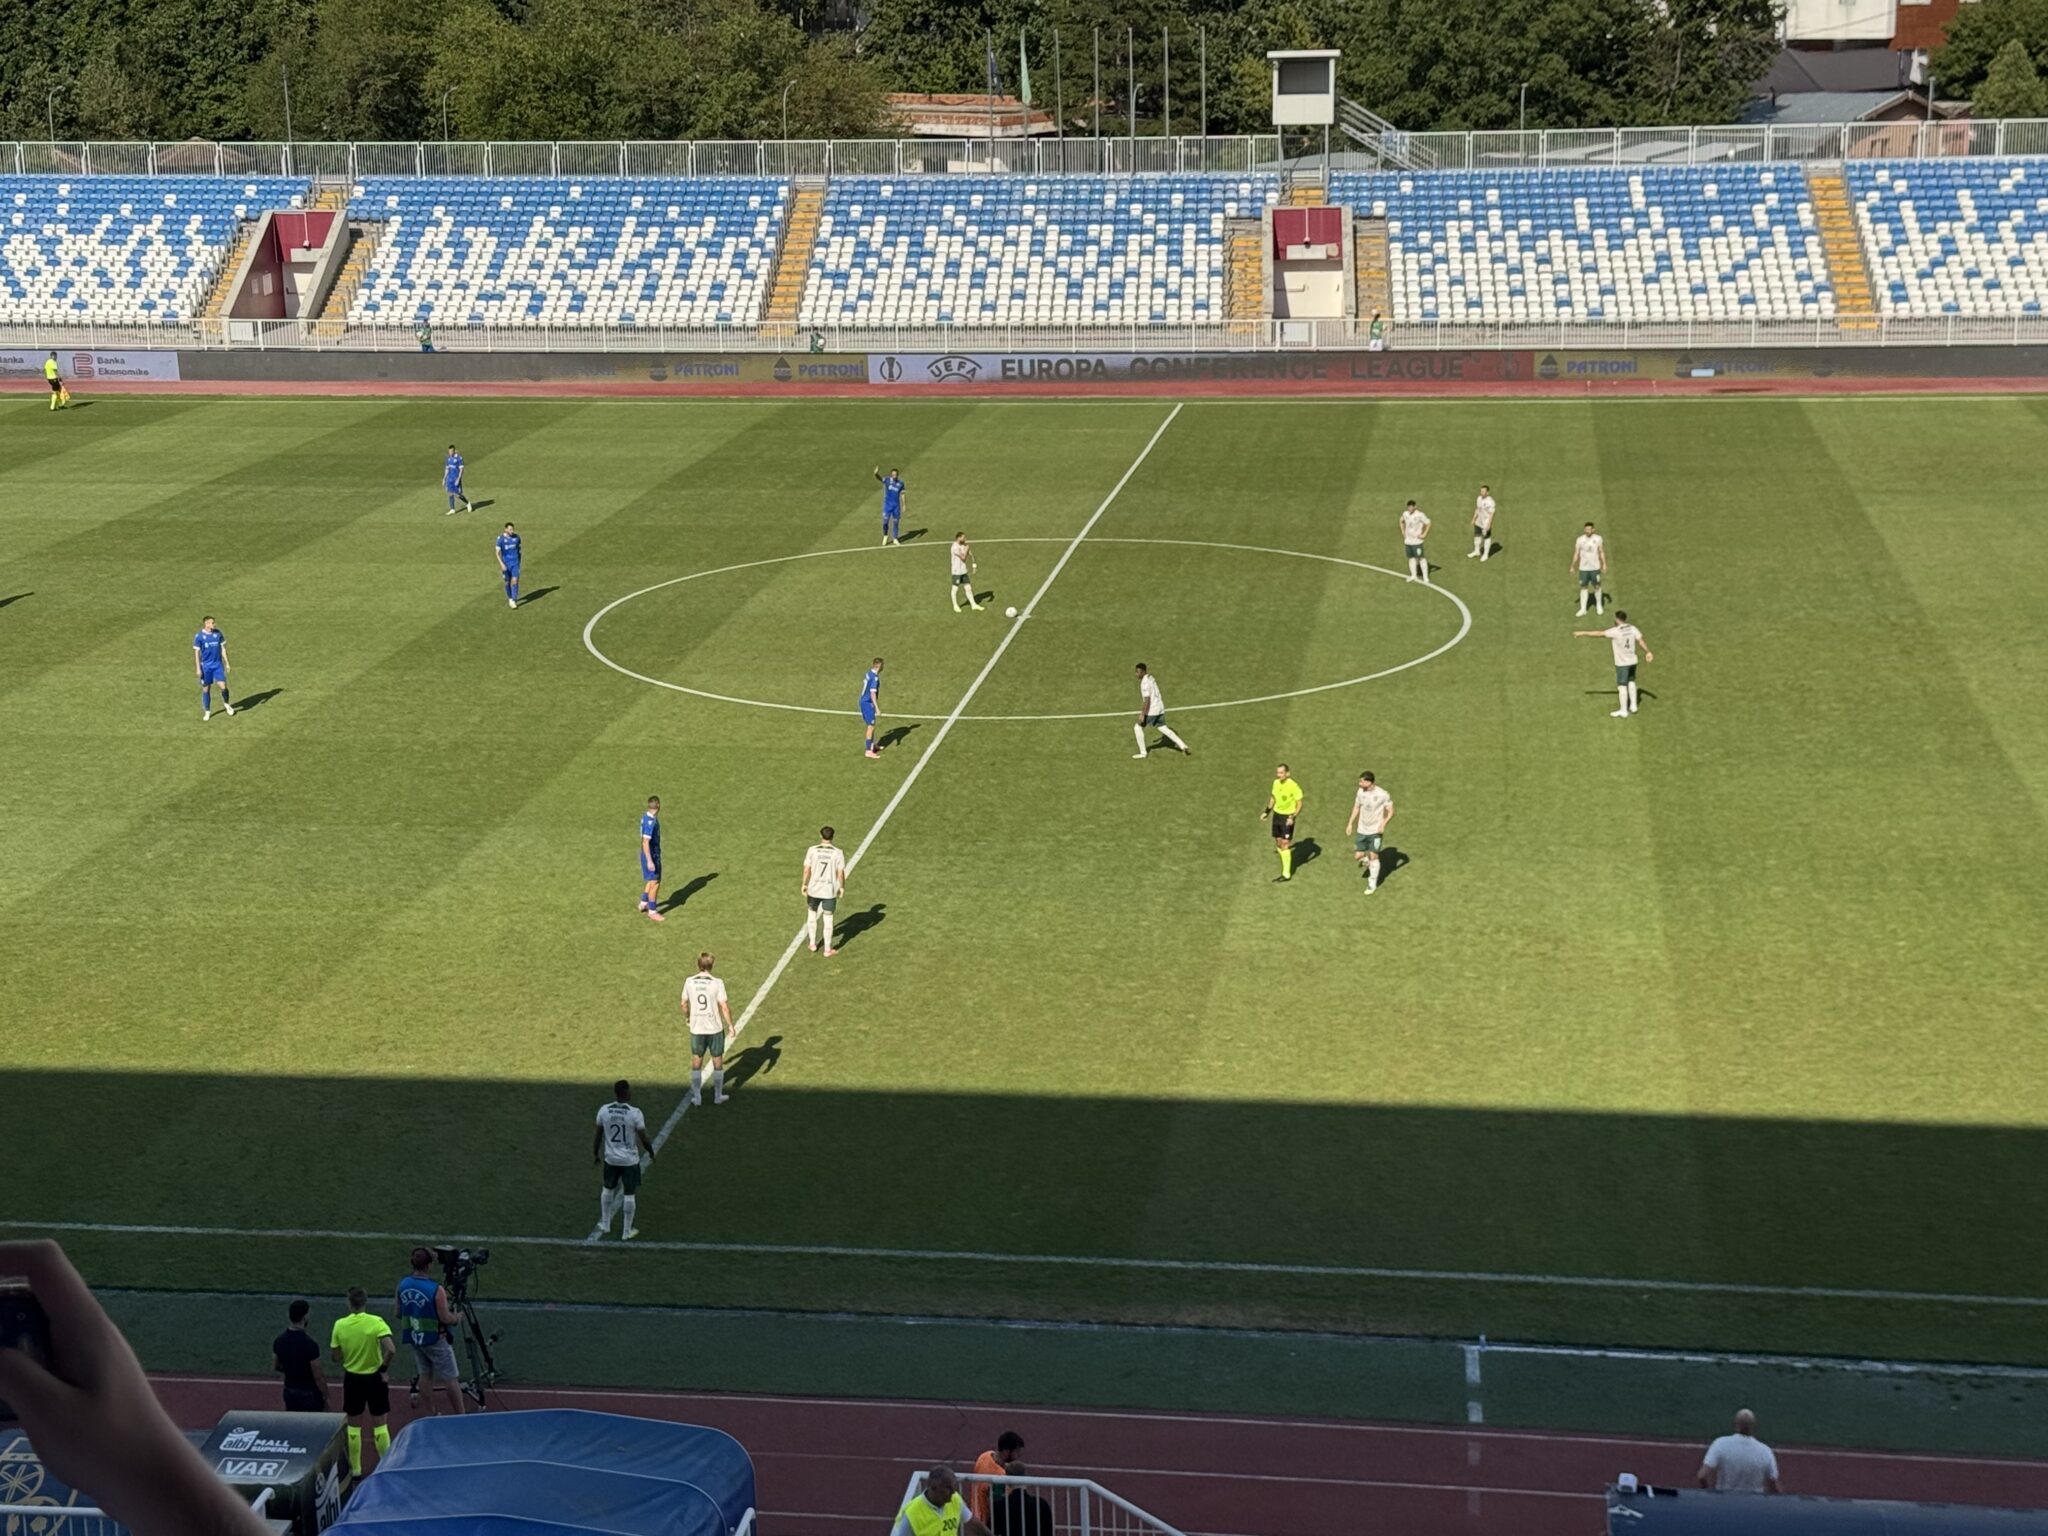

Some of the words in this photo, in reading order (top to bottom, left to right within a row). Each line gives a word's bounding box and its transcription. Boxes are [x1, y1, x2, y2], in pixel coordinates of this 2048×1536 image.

[97, 356, 126, 365] Banka
[1001, 358, 1107, 380] EUROPA
[1129, 357, 1328, 380] CONFERENCE
[1351, 356, 1465, 379] LEAGUE
[98, 367, 150, 376] Ekonomike
[930, 360, 977, 378] UEFA
[820, 861, 828, 877] 7
[697, 994, 708, 1011] 9
[610, 1124, 626, 1143] 21
[400, 1291, 426, 1306] UEFA
[250, 1446, 307, 1454] SUPERLIGA
[253, 1439, 290, 1447] MALL
[225, 1461, 279, 1475] VAR
